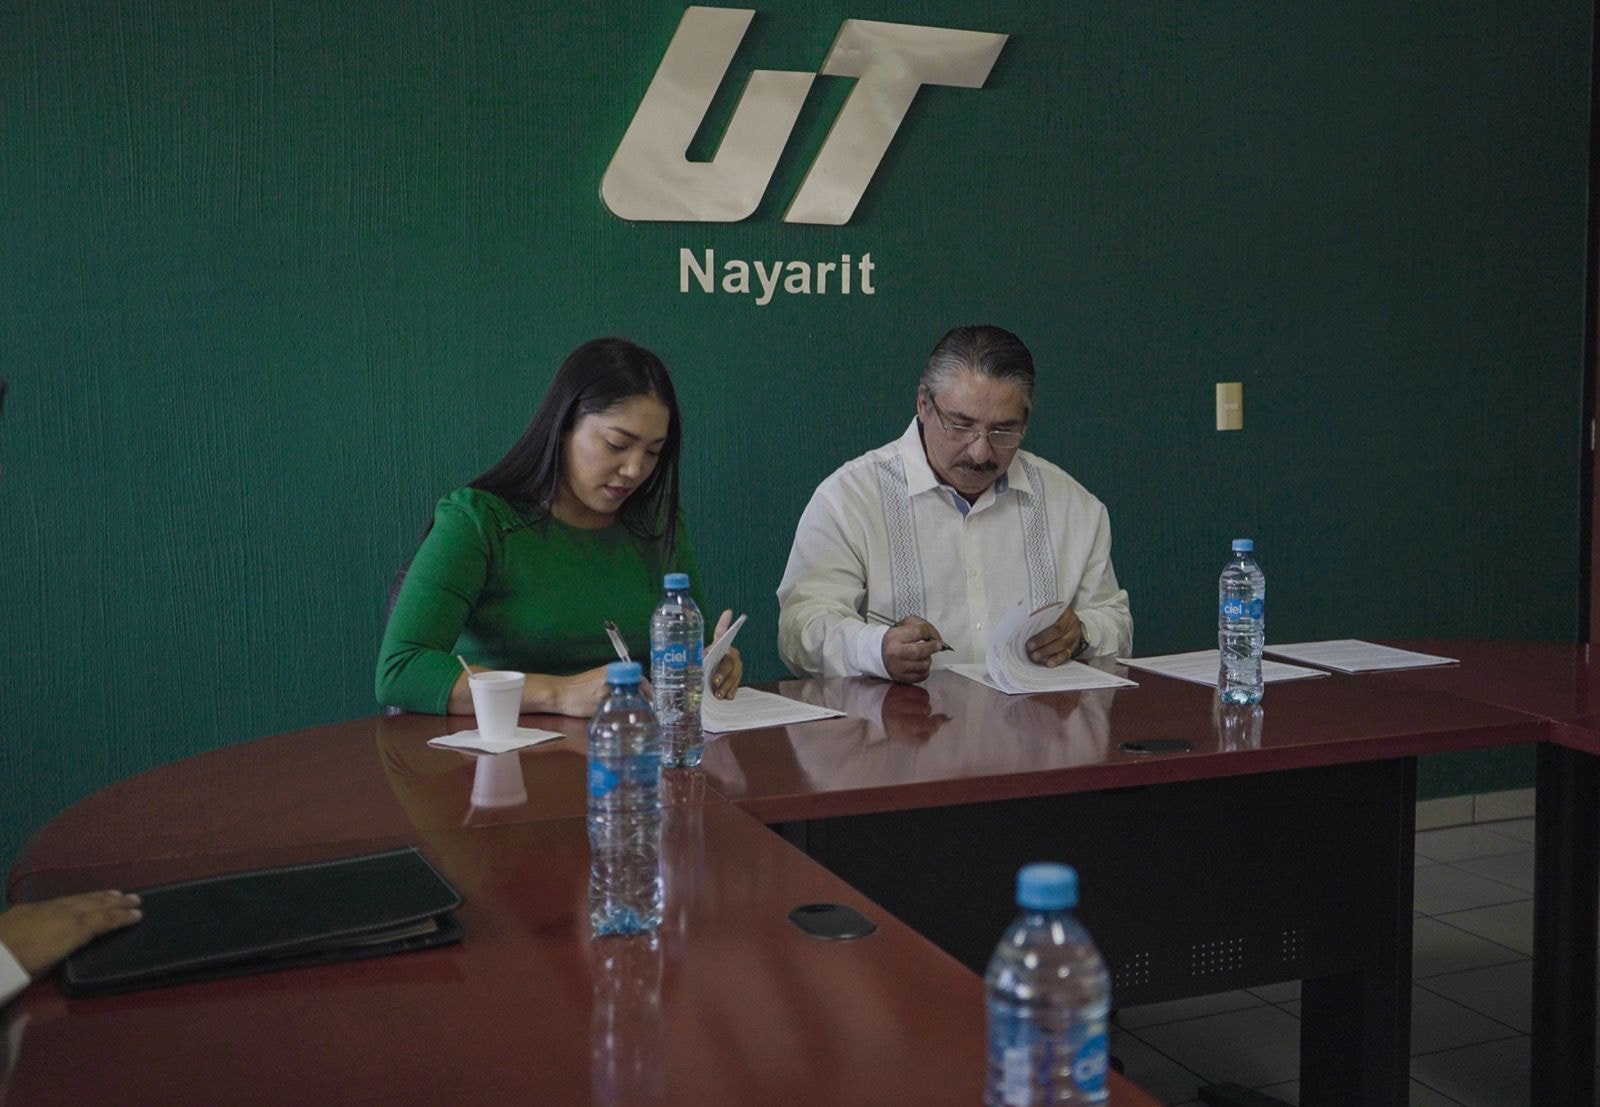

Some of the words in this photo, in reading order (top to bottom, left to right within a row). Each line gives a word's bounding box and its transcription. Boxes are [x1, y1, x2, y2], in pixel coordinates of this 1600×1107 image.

[600, 5, 1009, 225] UT
[679, 247, 876, 306] Nayarit
[1224, 602, 1242, 615] ciel
[663, 649, 686, 663] ciel
